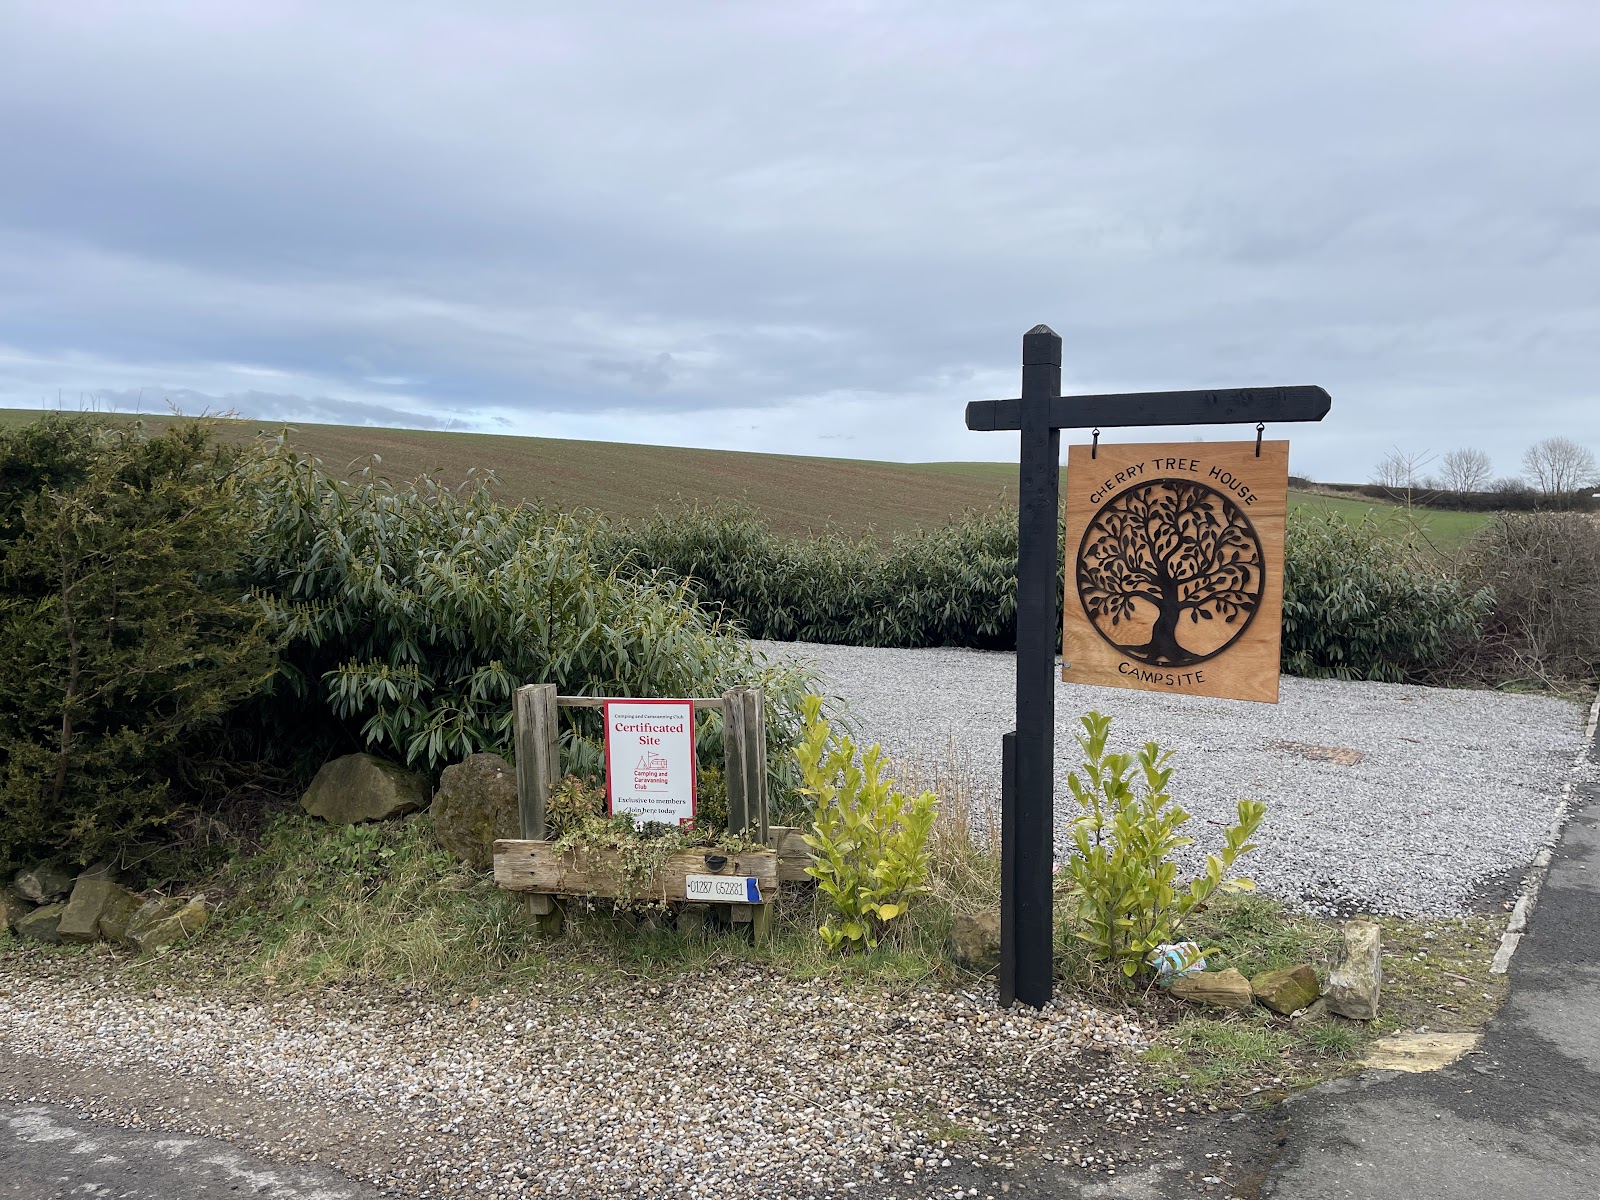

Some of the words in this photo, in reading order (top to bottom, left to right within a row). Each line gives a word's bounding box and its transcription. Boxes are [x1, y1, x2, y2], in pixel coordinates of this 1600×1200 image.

[1089, 462, 1145, 505] CHERRY
[1151, 457, 1201, 473] TREE
[1208, 465, 1258, 506] HOUSE
[1118, 661, 1206, 686] CAMPSITE
[615, 722, 683, 733] Certificated
[639, 735, 661, 745] Site
[618, 796, 648, 804] Exclusive
[690, 880, 712, 894] 01287
